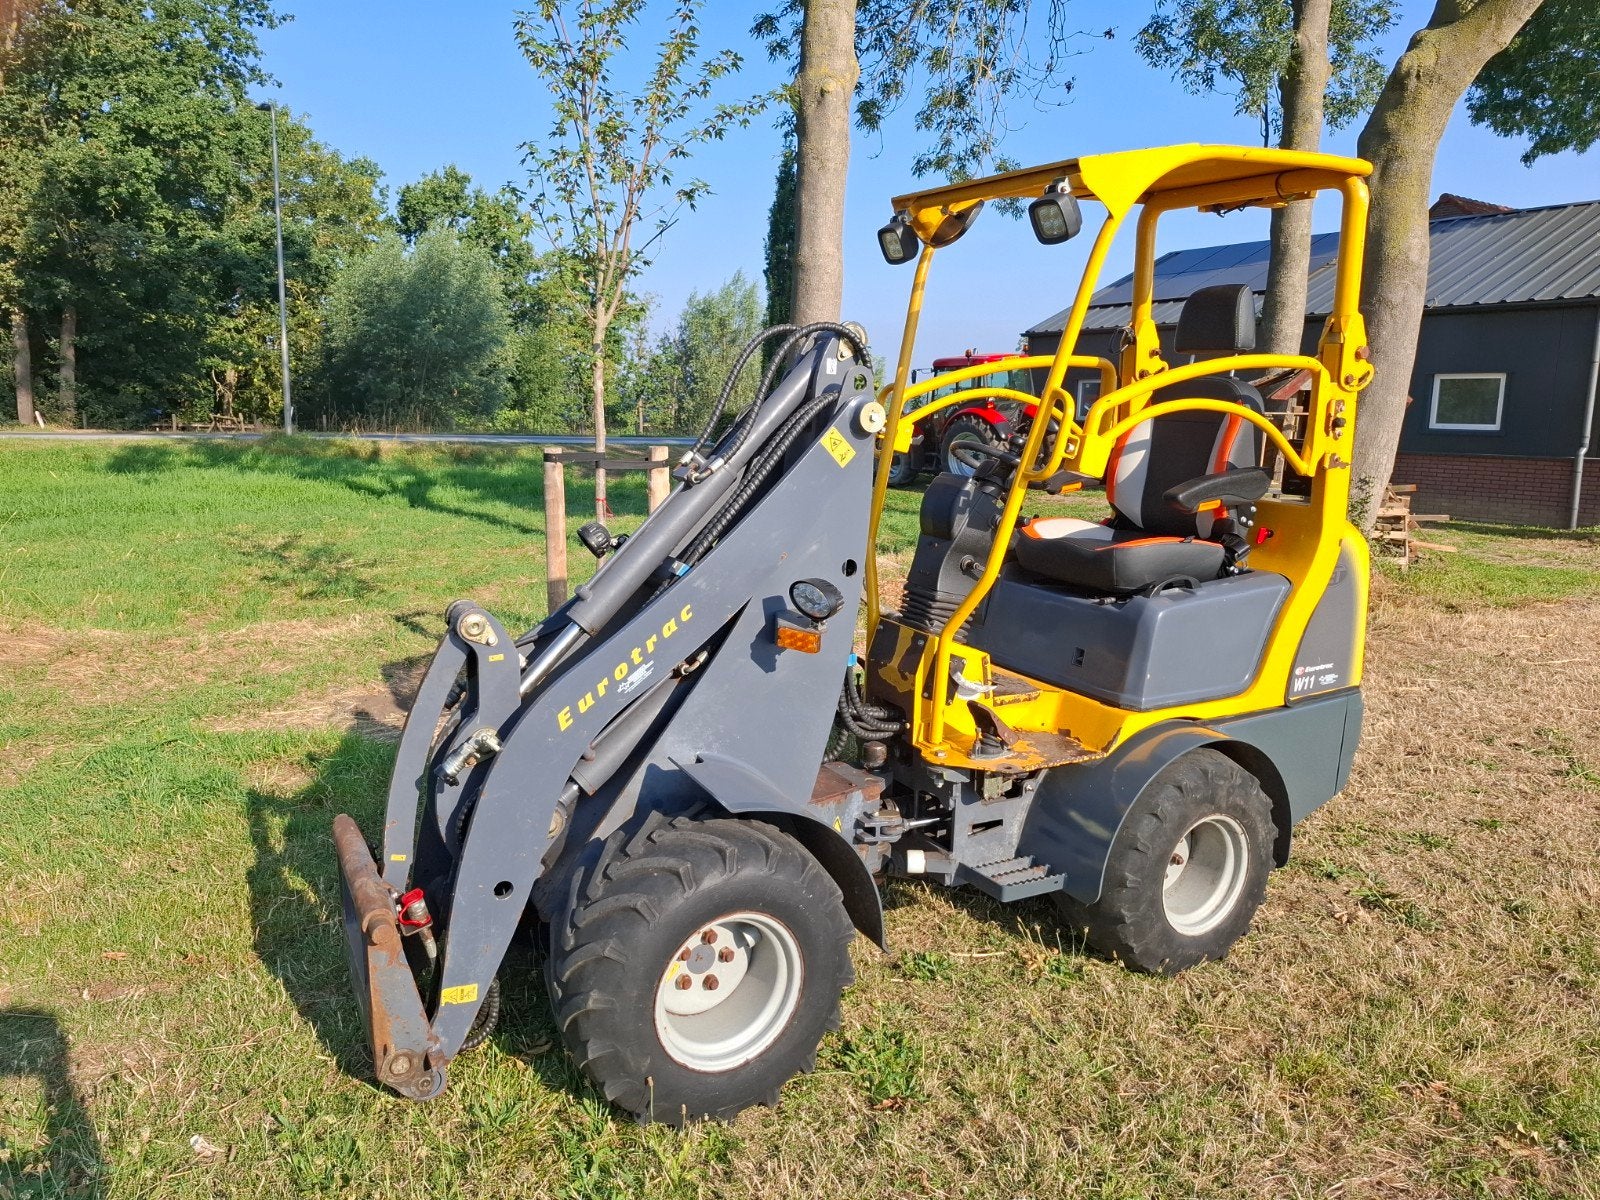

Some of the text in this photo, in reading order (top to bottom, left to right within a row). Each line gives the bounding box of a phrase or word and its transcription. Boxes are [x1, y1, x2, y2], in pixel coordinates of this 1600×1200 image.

[557, 604, 693, 732] Eurotrac
[1305, 662, 1334, 673] Eurotrac
[1294, 675, 1315, 692] W11
